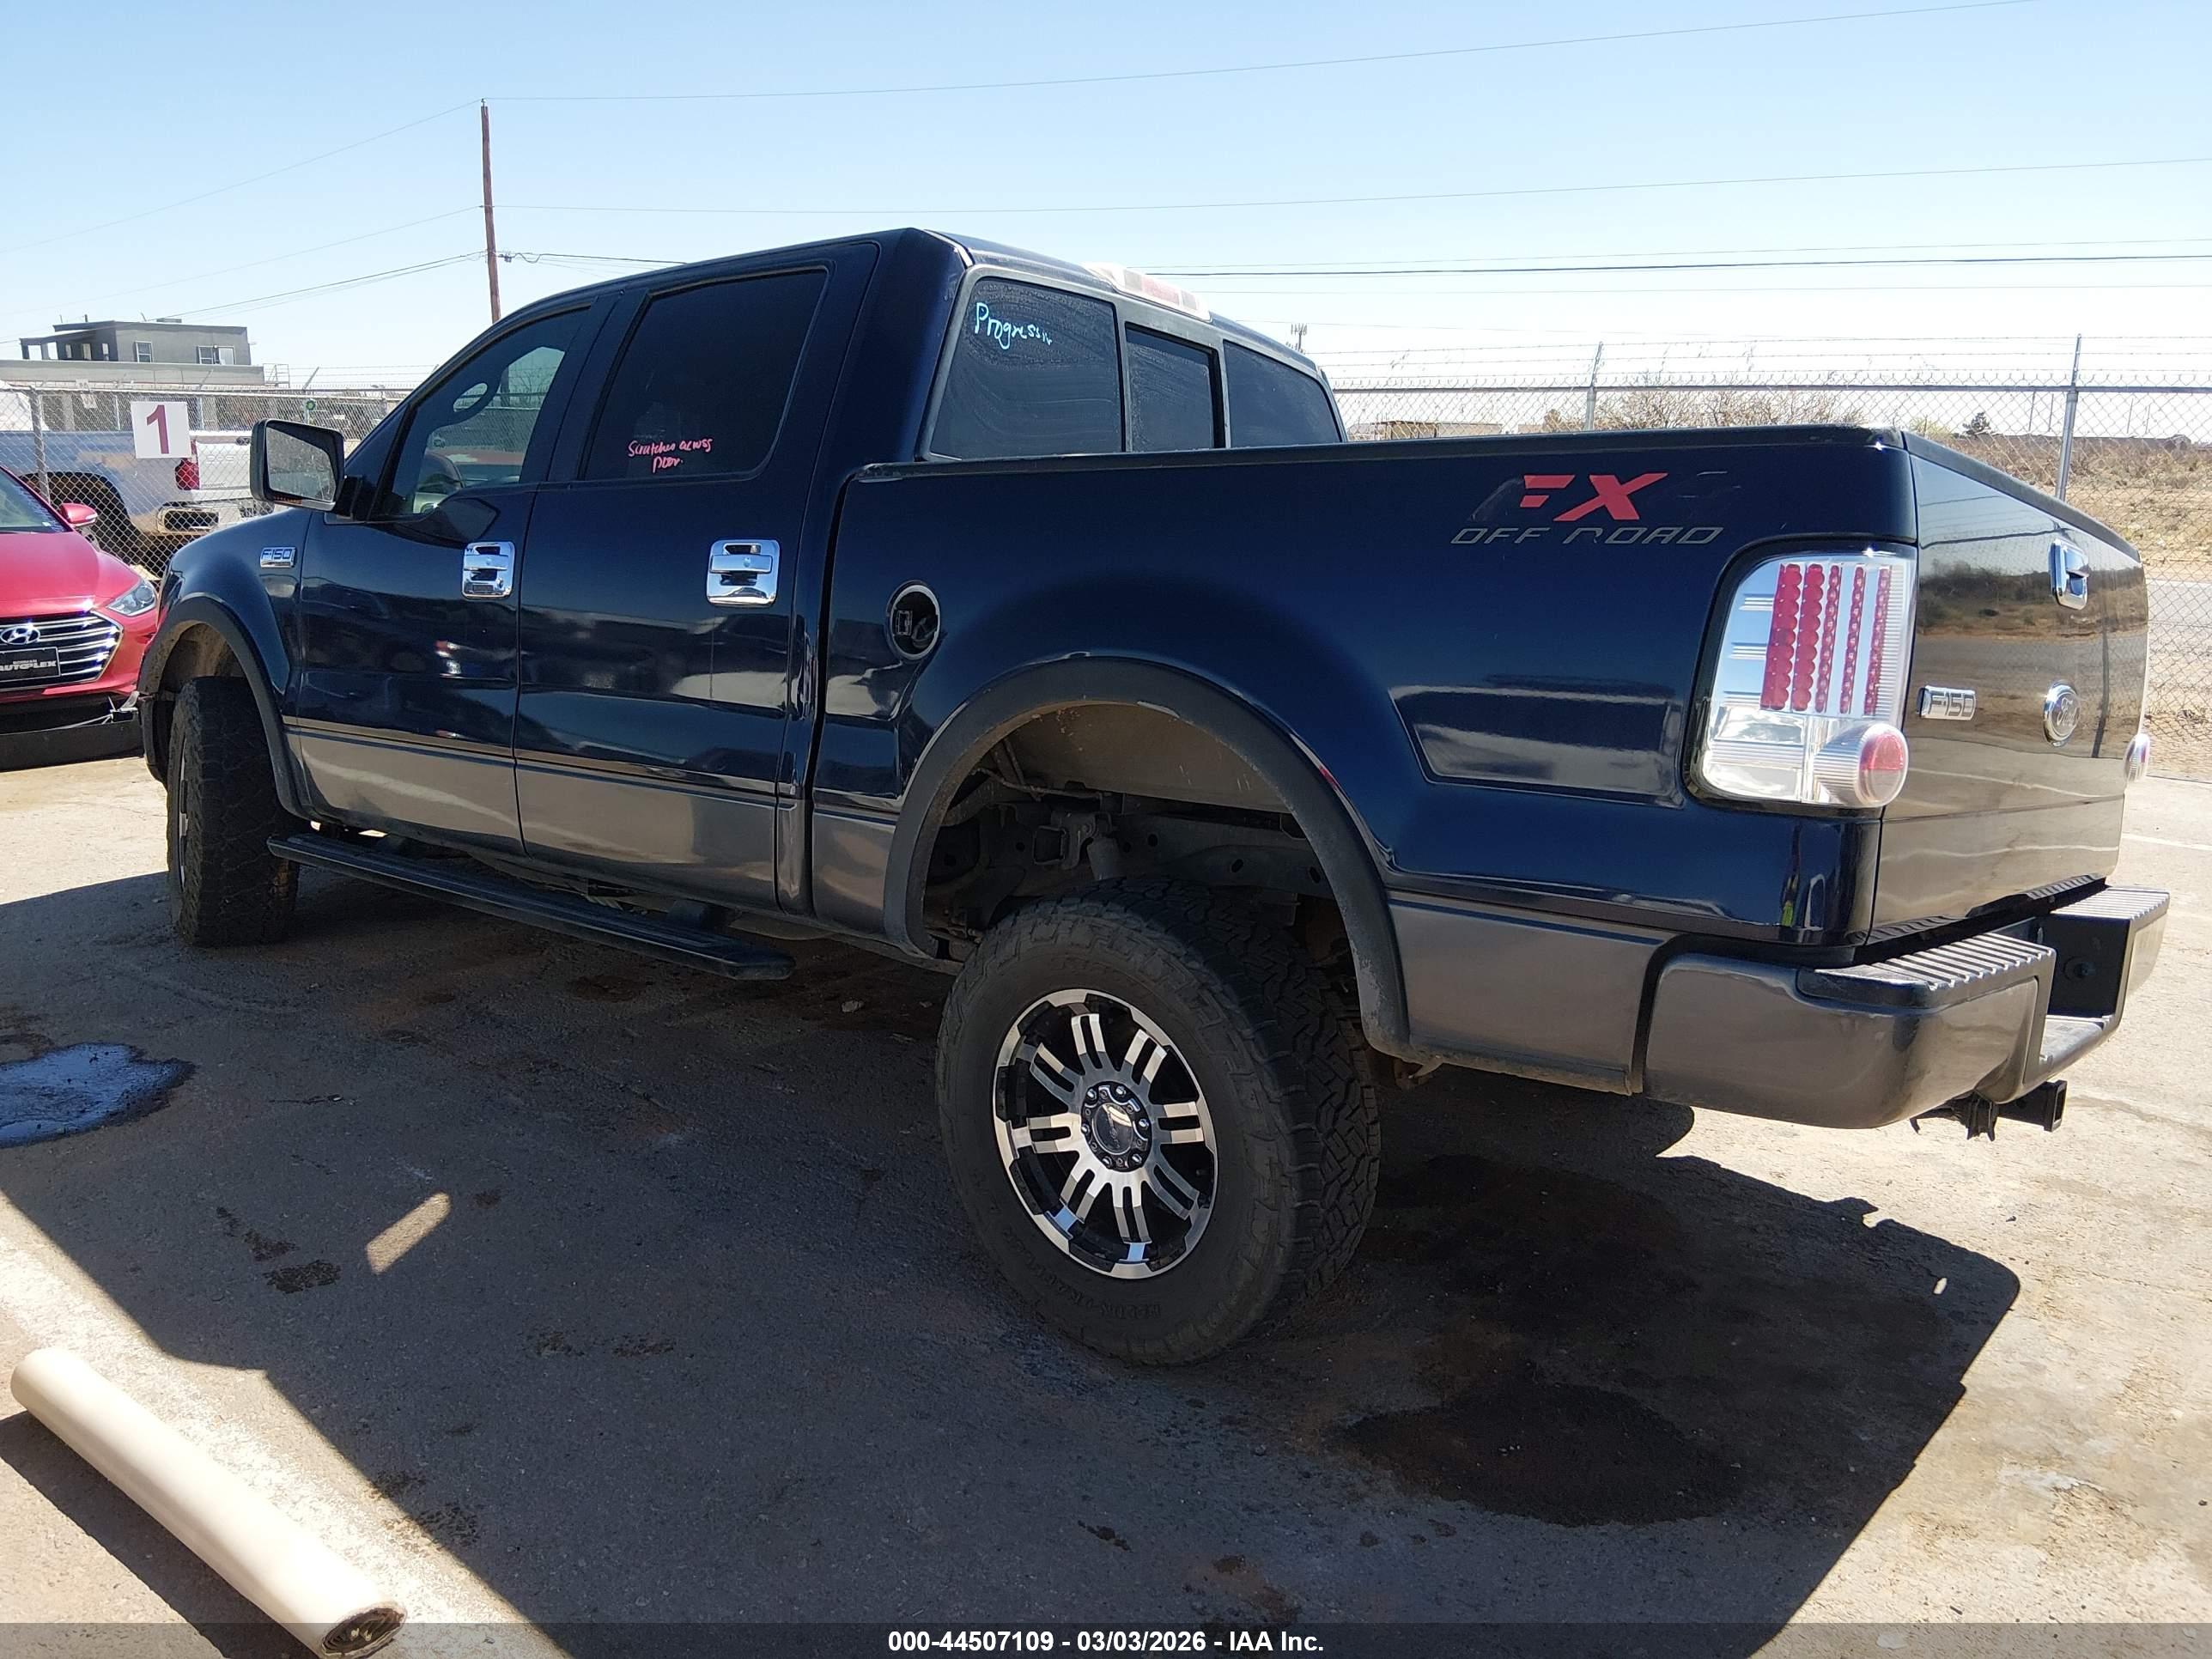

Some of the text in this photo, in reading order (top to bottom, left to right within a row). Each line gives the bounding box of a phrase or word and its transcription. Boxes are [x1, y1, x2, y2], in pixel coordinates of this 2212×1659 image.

[146, 404, 169, 454] 1
[1450, 526, 1724, 544] OFF ROAD
[2056, 696, 2081, 727] Ford
